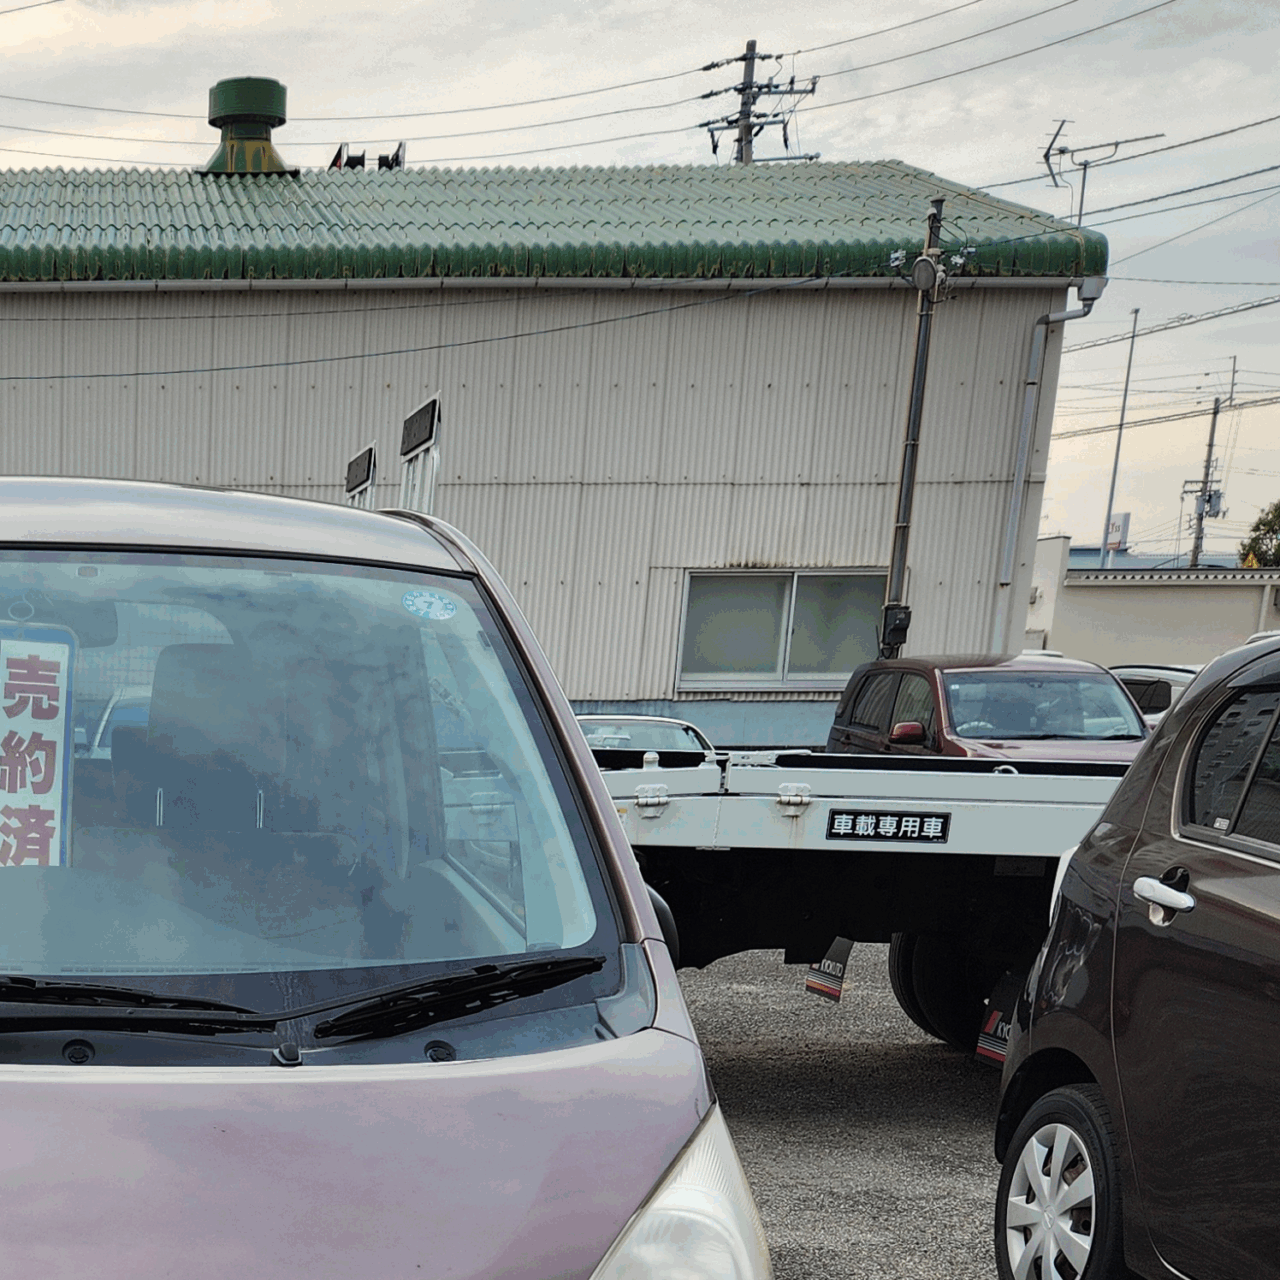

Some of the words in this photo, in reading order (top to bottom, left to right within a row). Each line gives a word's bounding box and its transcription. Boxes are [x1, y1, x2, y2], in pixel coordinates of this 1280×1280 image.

[422, 600, 435, 610] 7
[831, 814, 944, 838] 車載専用車
